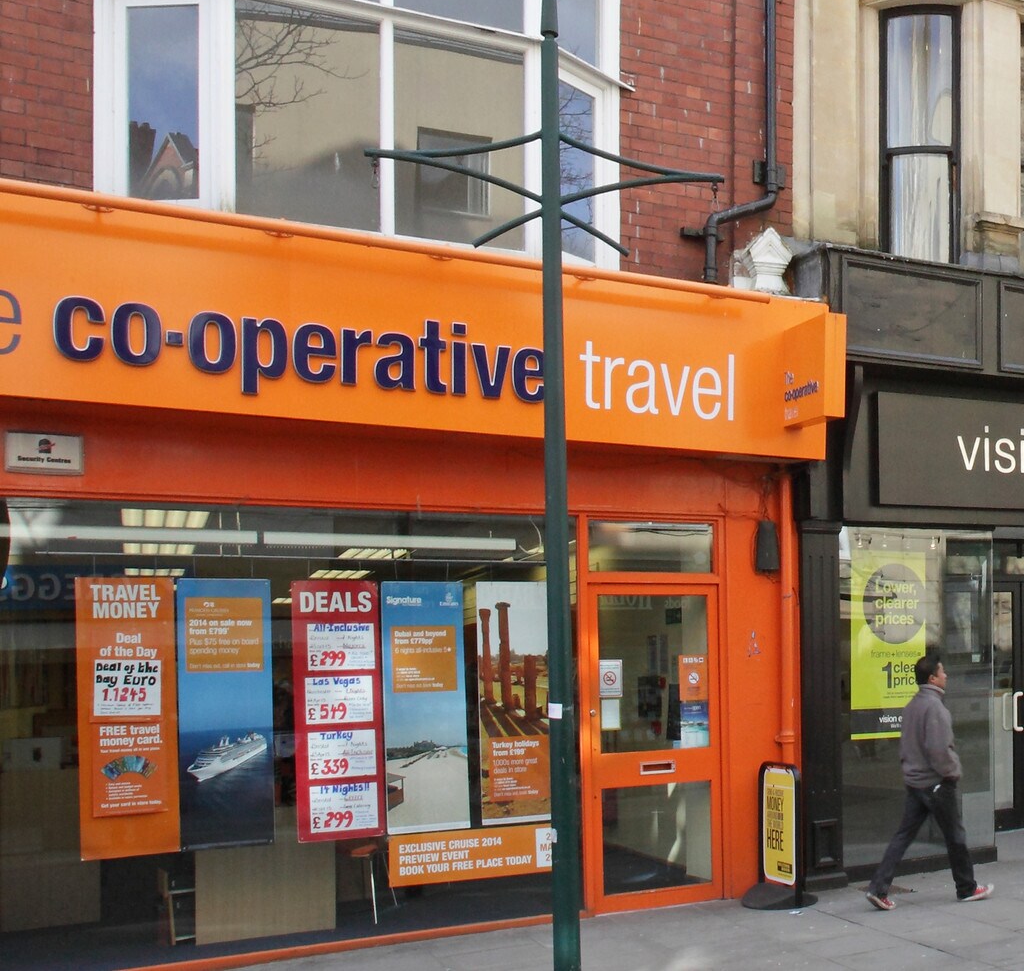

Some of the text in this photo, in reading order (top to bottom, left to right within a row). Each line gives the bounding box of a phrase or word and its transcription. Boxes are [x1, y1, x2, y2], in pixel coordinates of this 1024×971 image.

[53, 295, 545, 404] co-operative
[579, 340, 735, 421] travel
[90, 584, 161, 601] TRAVEL
[875, 579, 917, 596] Lower,
[300, 591, 372, 613] DEALS
[386, 595, 422, 605] Signature
[875, 596, 919, 609] clearer
[92, 601, 159, 619] MONEY
[875, 612, 915, 627] prices
[313, 623, 370, 632] All-Inclusive
[425, 630, 447, 638] beyond
[116, 632, 142, 644] Deal
[100, 646, 157, 659] of the Day
[96, 661, 158, 674] Deal of the
[96, 675, 156, 687] Day Euro
[882, 661, 916, 688] 1 clea
[893, 674, 916, 688] pric
[312, 677, 361, 688] Las Vegas
[879, 714, 897, 723] vision
[100, 724, 160, 736] FREE travel
[100, 734, 163, 747] money card.
[492, 740, 540, 749] Turkey holidays
[767, 796, 784, 811] MONEY
[399, 836, 502, 854] EXCLUSIVE CRUISE 2014
[767, 828, 784, 852] HERE
[399, 849, 469, 864] PREVIEW EVENT
[399, 855, 532, 876] BOOK YOUR FREE PLACE TODAY
